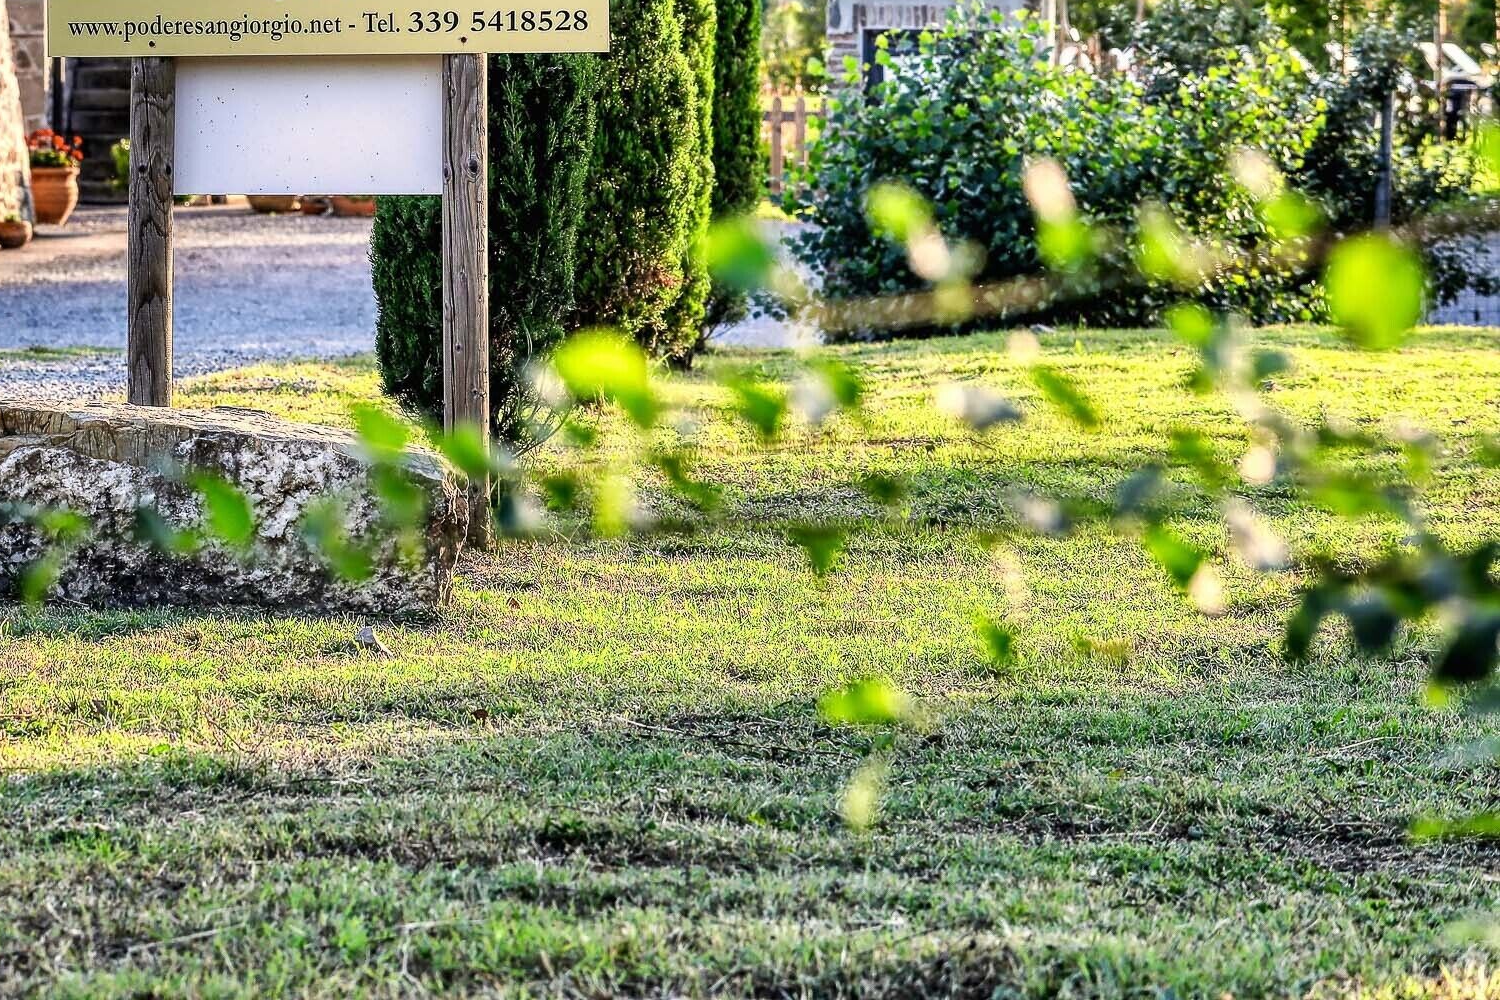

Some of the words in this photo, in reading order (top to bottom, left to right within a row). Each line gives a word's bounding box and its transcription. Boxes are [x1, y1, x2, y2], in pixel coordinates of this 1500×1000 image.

[68, 13, 342, 41] www.poderesangiorgio.net
[362, 12, 401, 33] Tel.
[407, 11, 459, 33] 339
[470, 10, 589, 32] 5418528
